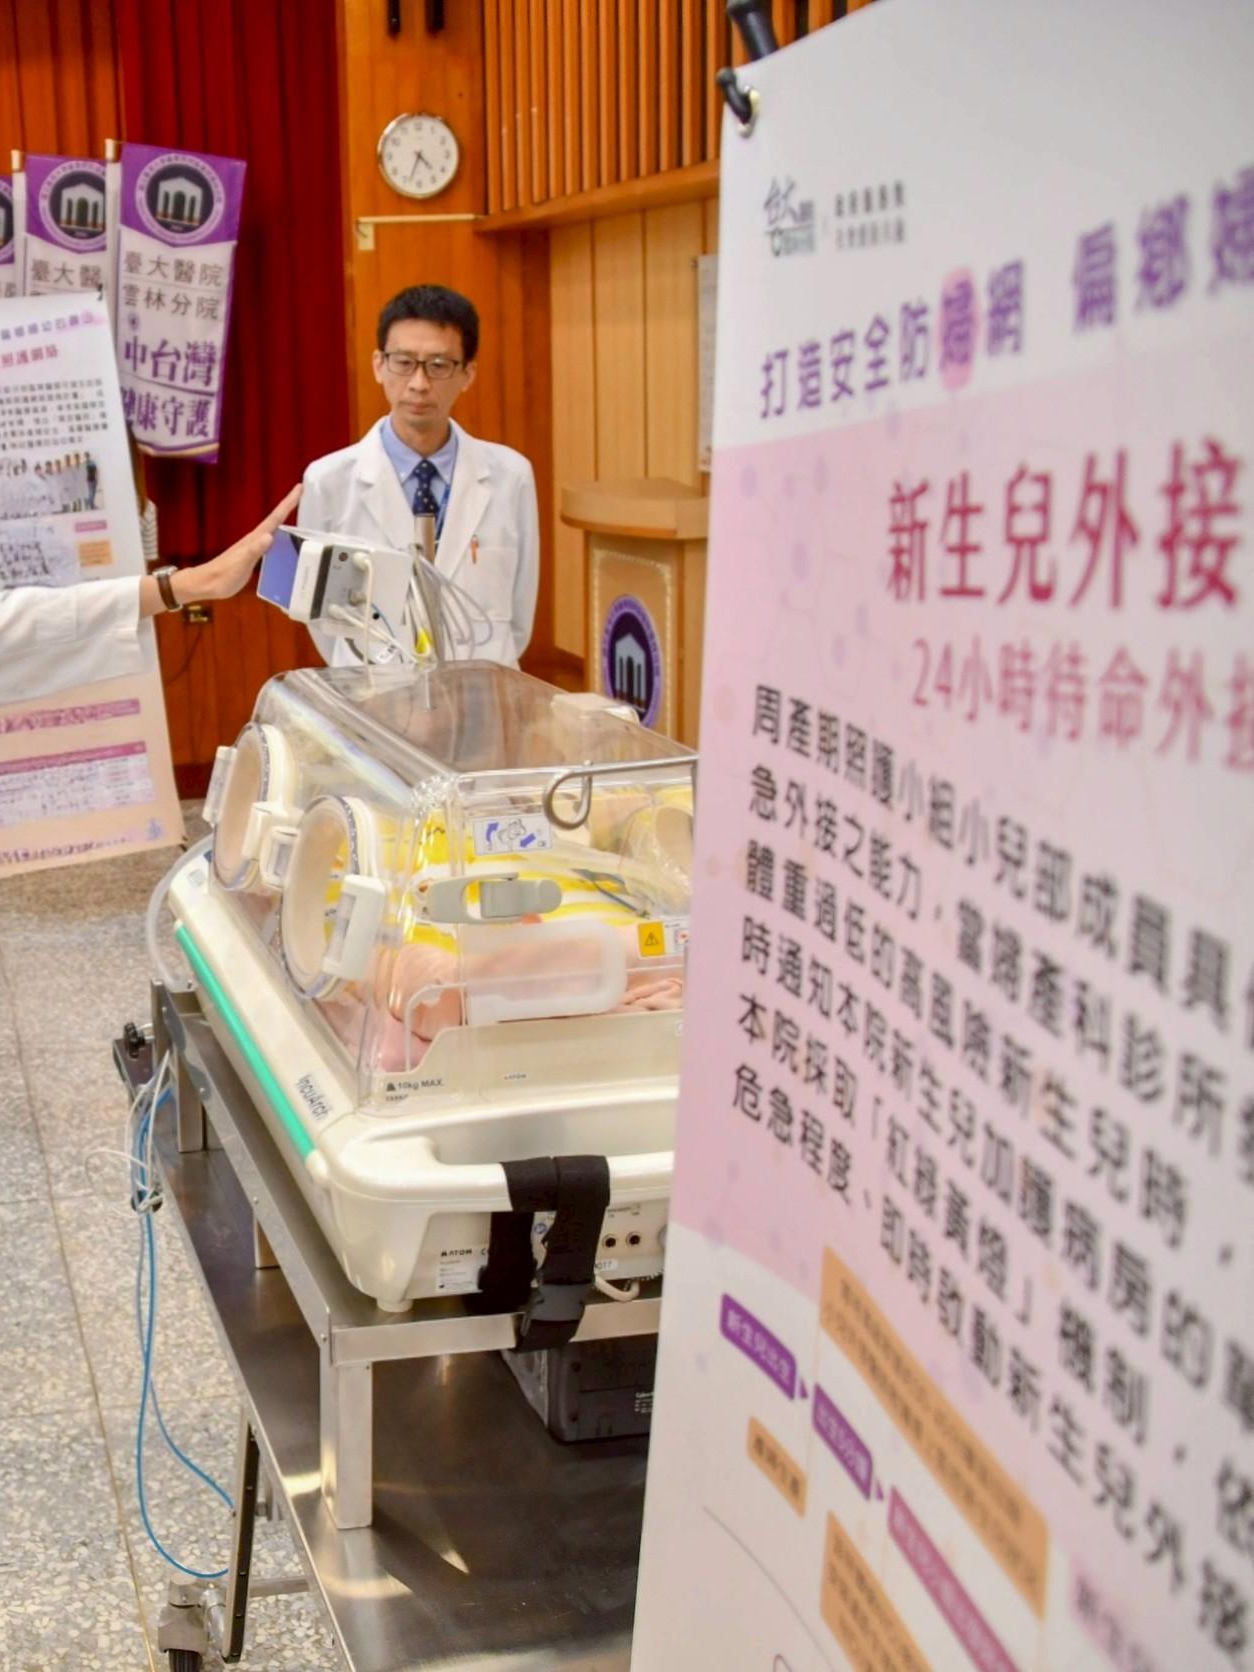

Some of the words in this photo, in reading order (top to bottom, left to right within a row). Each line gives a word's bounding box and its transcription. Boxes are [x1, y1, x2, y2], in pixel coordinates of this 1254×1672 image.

[32, 259, 101, 288] 臺大醫
[123, 251, 224, 287] 臺大醫院
[122, 283, 220, 321] 雲林分院
[124, 335, 217, 387] 中台灣
[120, 386, 211, 438] 健康守護
[886, 434, 1242, 610] 新生兒外接
[752, 684, 1254, 1052] 周產期照護小組小兒部成員具
